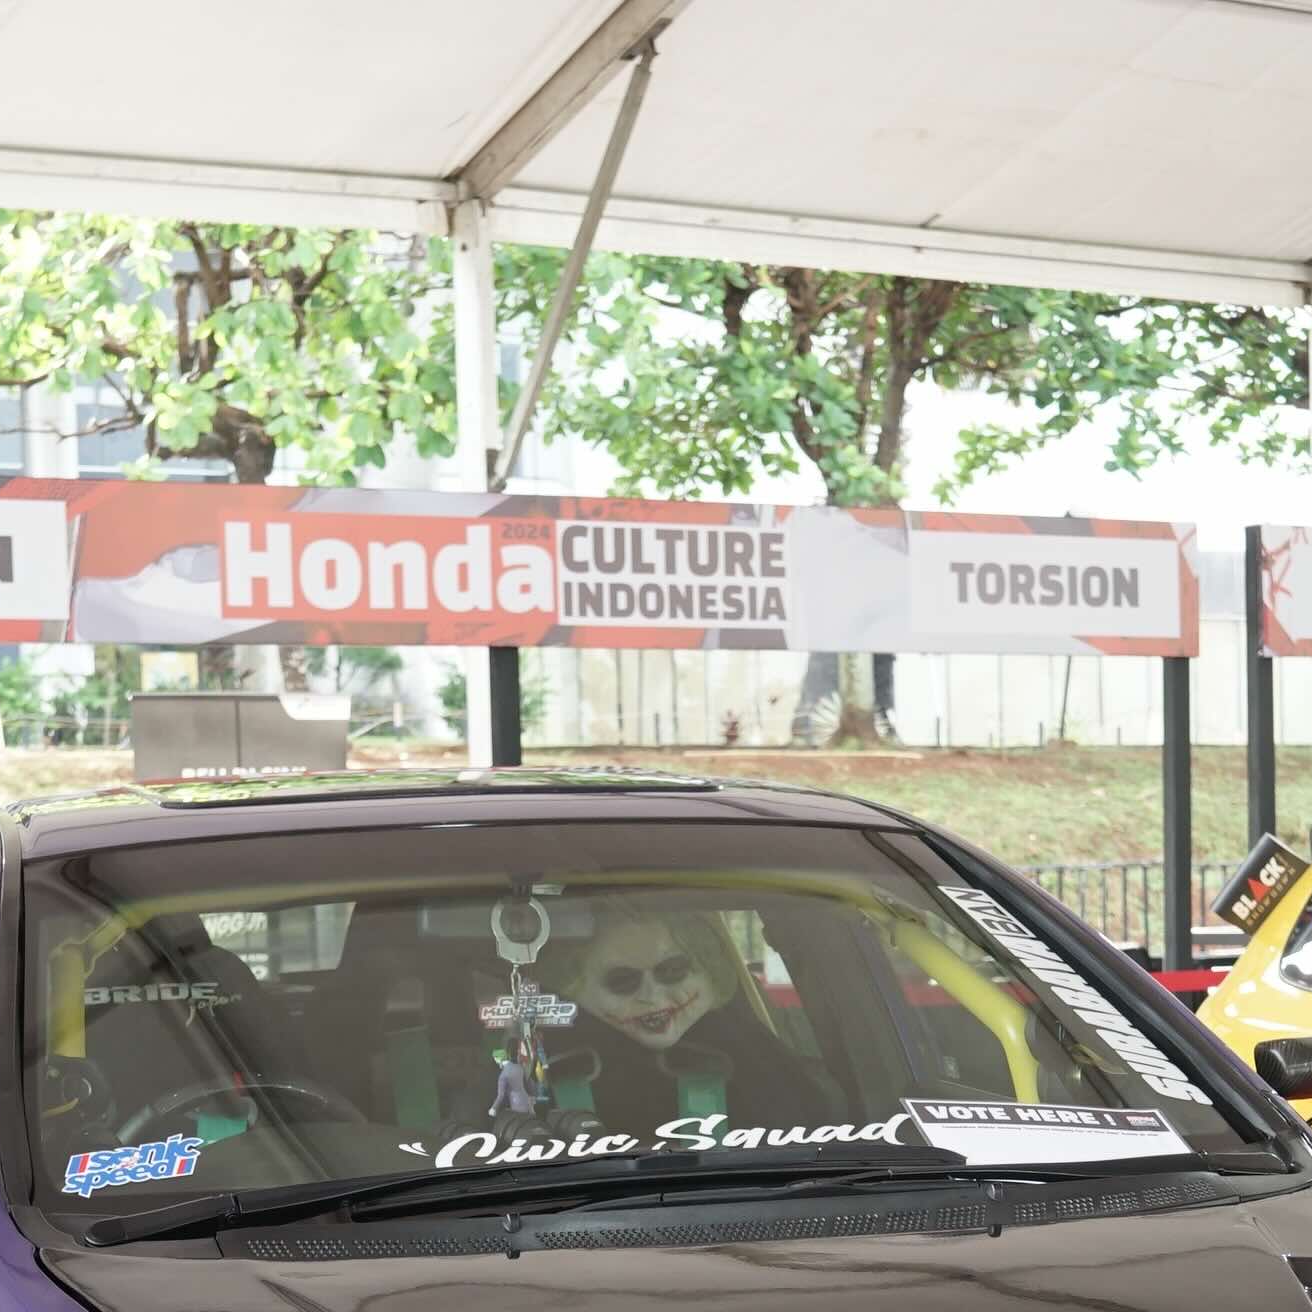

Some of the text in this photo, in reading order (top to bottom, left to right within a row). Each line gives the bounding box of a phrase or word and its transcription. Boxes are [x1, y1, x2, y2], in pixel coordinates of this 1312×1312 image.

[501, 522, 551, 541] 2024
[560, 525, 786, 578] CULTURE
[224, 521, 554, 613] Honda
[951, 562, 1141, 608] TORSION
[562, 581, 787, 622] INDONESIA
[84, 982, 219, 1005] BRIDE
[924, 1104, 1012, 1121] VOTE
[1014, 1107, 1101, 1126] HERE
[434, 1113, 912, 1168] Civic Squad
[61, 1155, 176, 1199] speed
